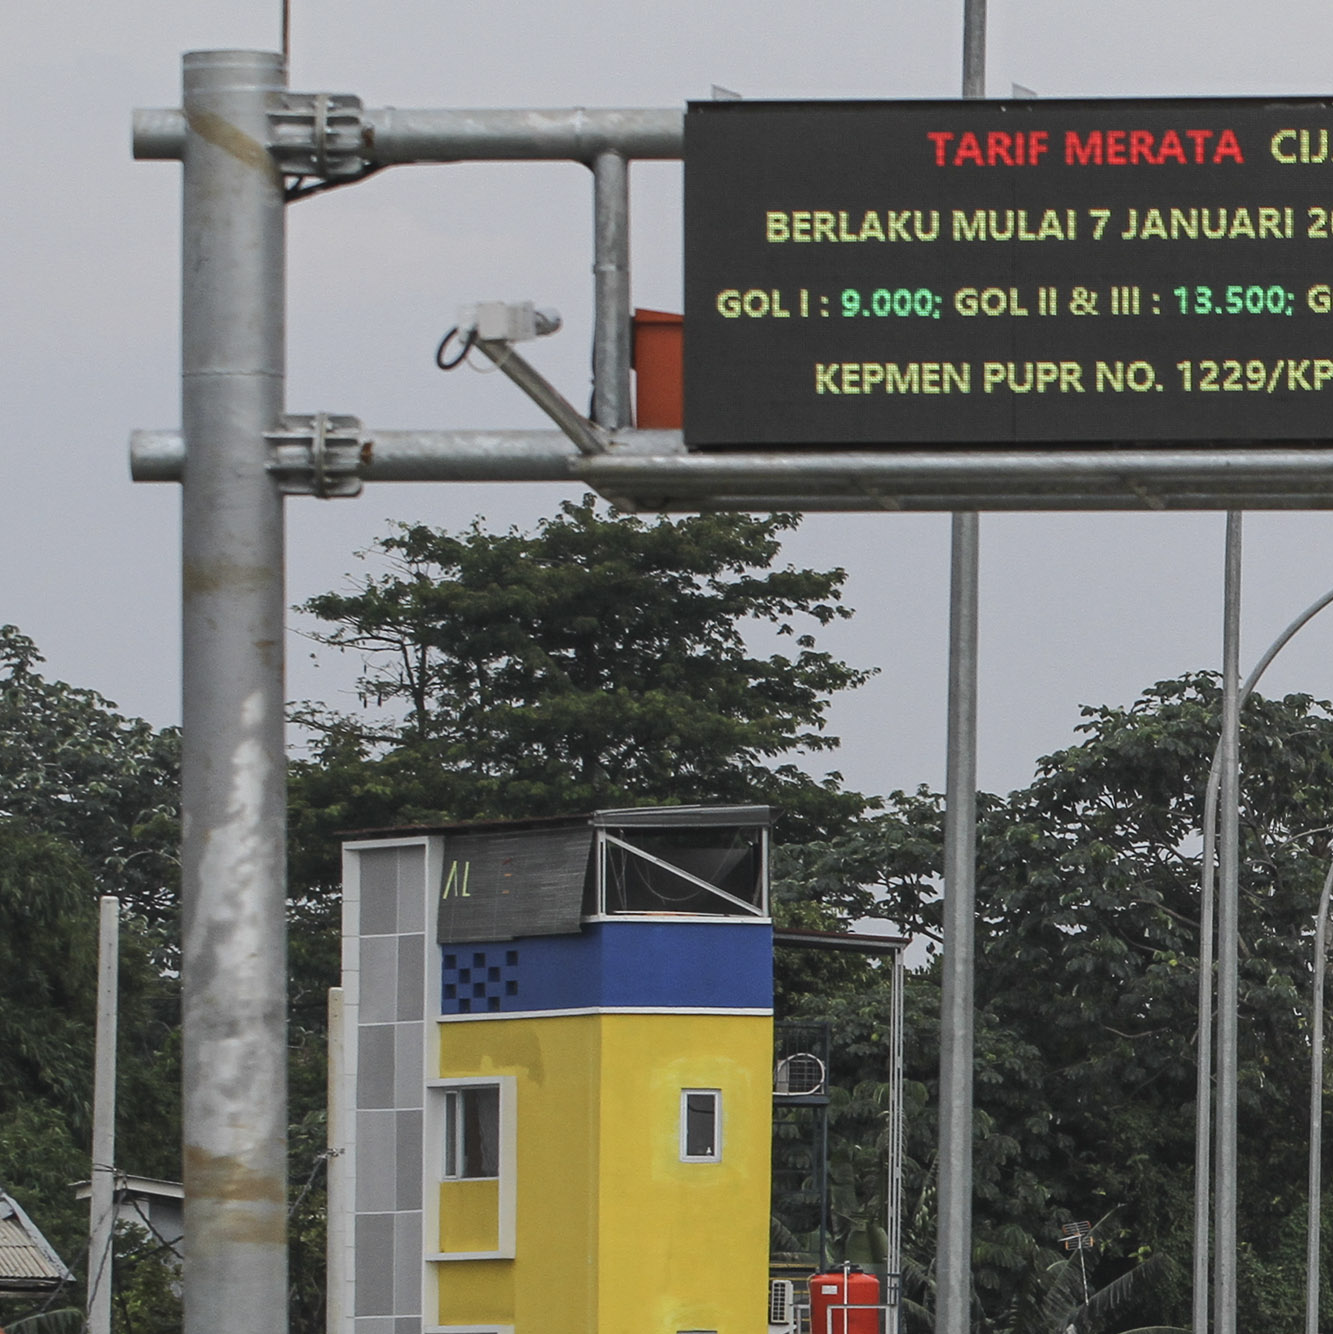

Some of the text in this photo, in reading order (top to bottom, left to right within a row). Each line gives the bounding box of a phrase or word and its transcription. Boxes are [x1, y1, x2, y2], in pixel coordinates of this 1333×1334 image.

[927, 131, 1048, 166] TARIF
[1065, 130, 1244, 165] MERATA
[766, 209, 940, 243] BERLAKU
[952, 208, 1077, 241] MULAI
[1090, 208, 1110, 240] 7
[1122, 207, 1294, 240] JANUARI
[716, 289, 790, 318] GOL
[800, 288, 808, 318] I
[840, 287, 942, 319] 9.000;
[954, 287, 1028, 317] GOL
[1038, 287, 1057, 317] II
[1069, 287, 1099, 316] &
[1111, 286, 1140, 316] III
[1174, 285, 1294, 316] 13.500;
[815, 362, 970, 395] KEPMEN
[983, 361, 1085, 394] PUPR
[1095, 360, 1163, 393] NO.
